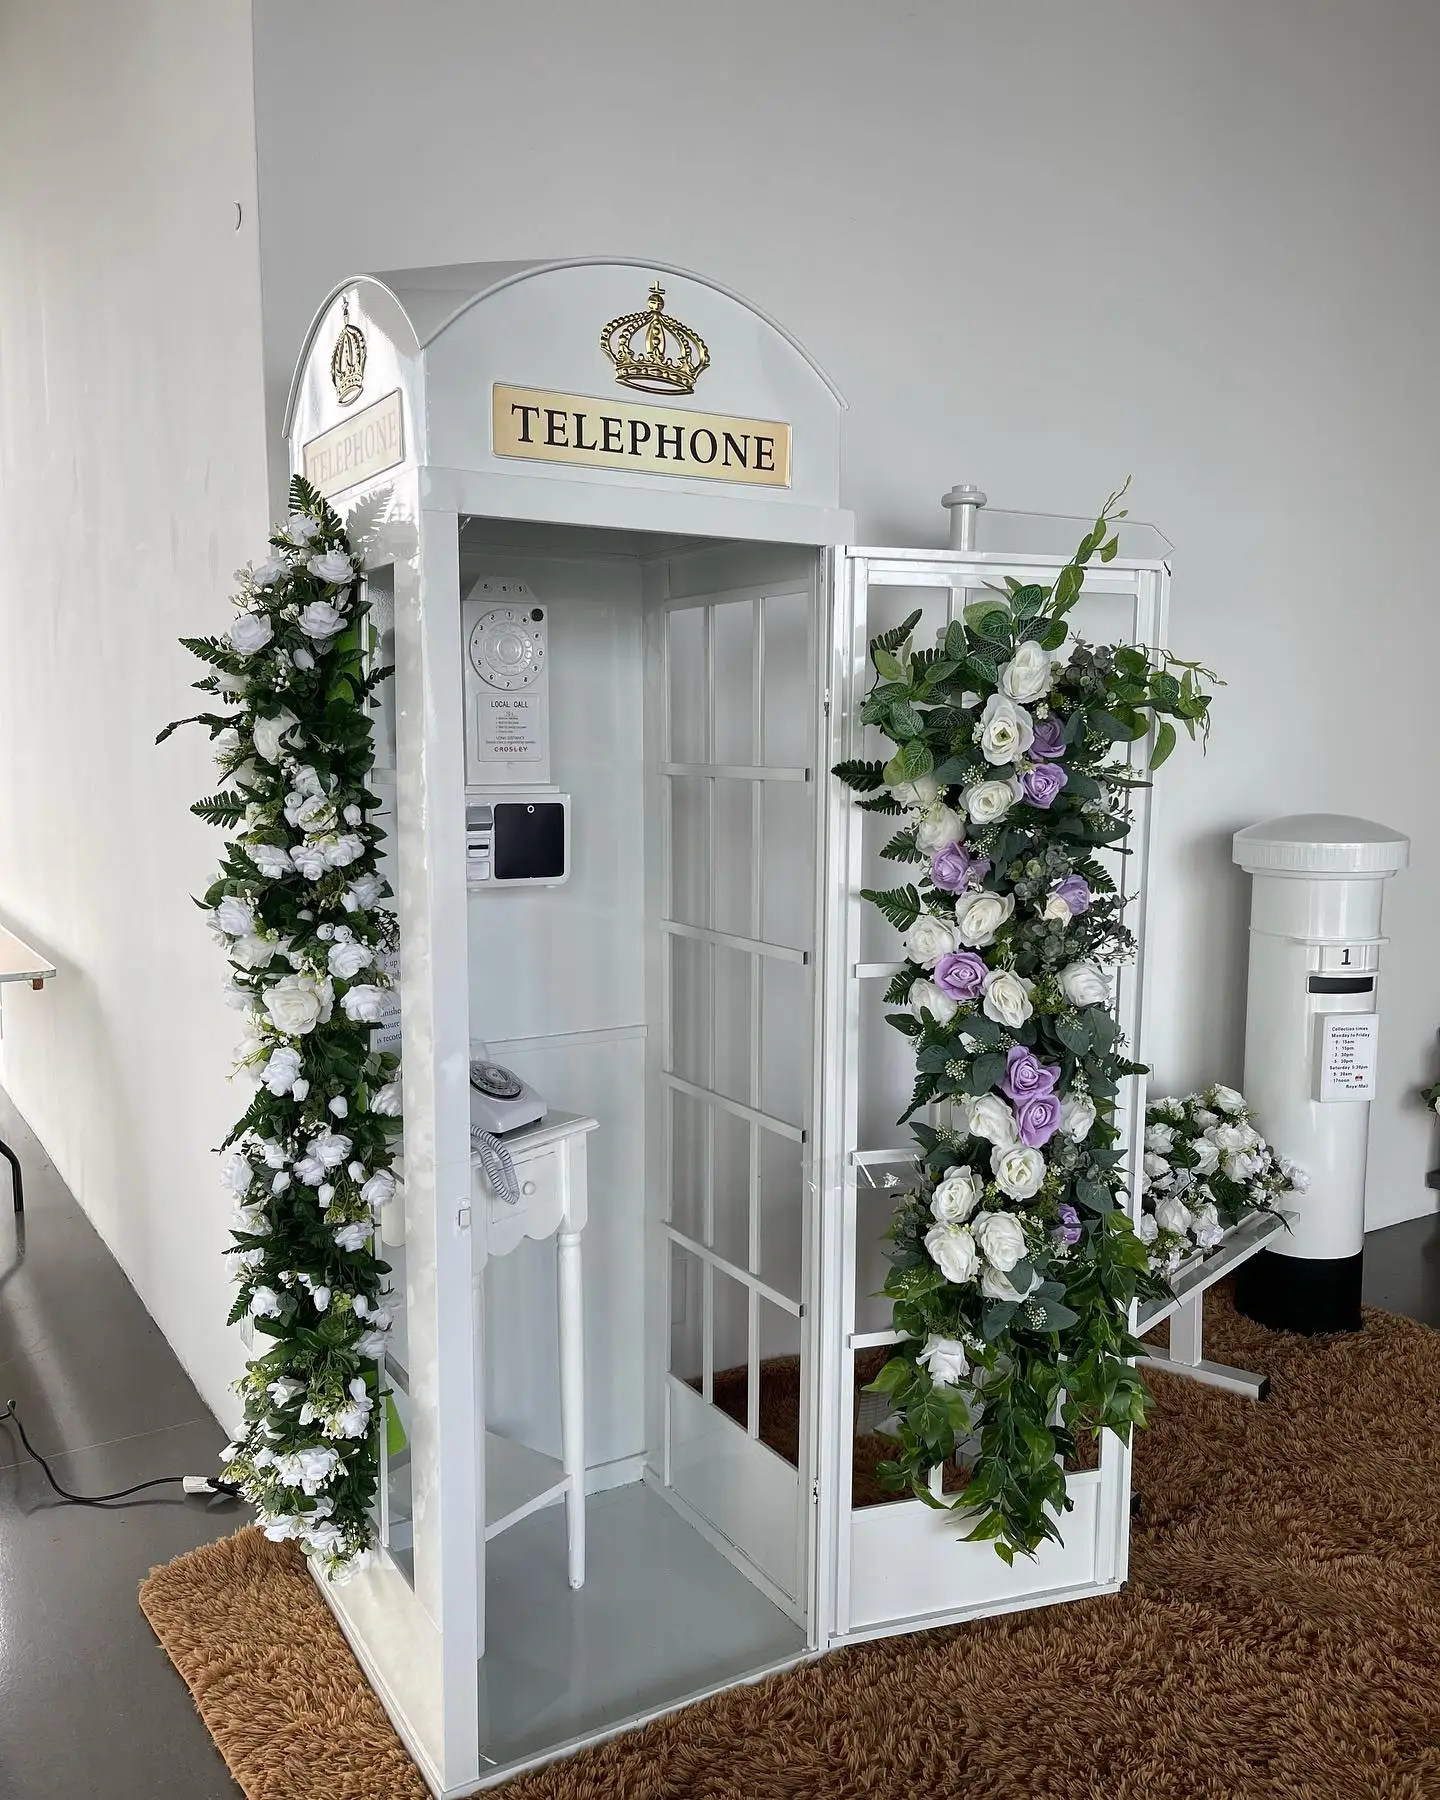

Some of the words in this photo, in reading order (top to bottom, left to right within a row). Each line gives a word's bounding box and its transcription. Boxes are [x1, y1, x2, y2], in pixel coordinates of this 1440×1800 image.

[311, 411, 397, 484] TELEPHONE
[511, 403, 775, 471] TELEPHONE
[490, 700, 510, 708] LOCAL
[513, 700, 529, 708] CALL
[1340, 948, 1352, 966] 1
